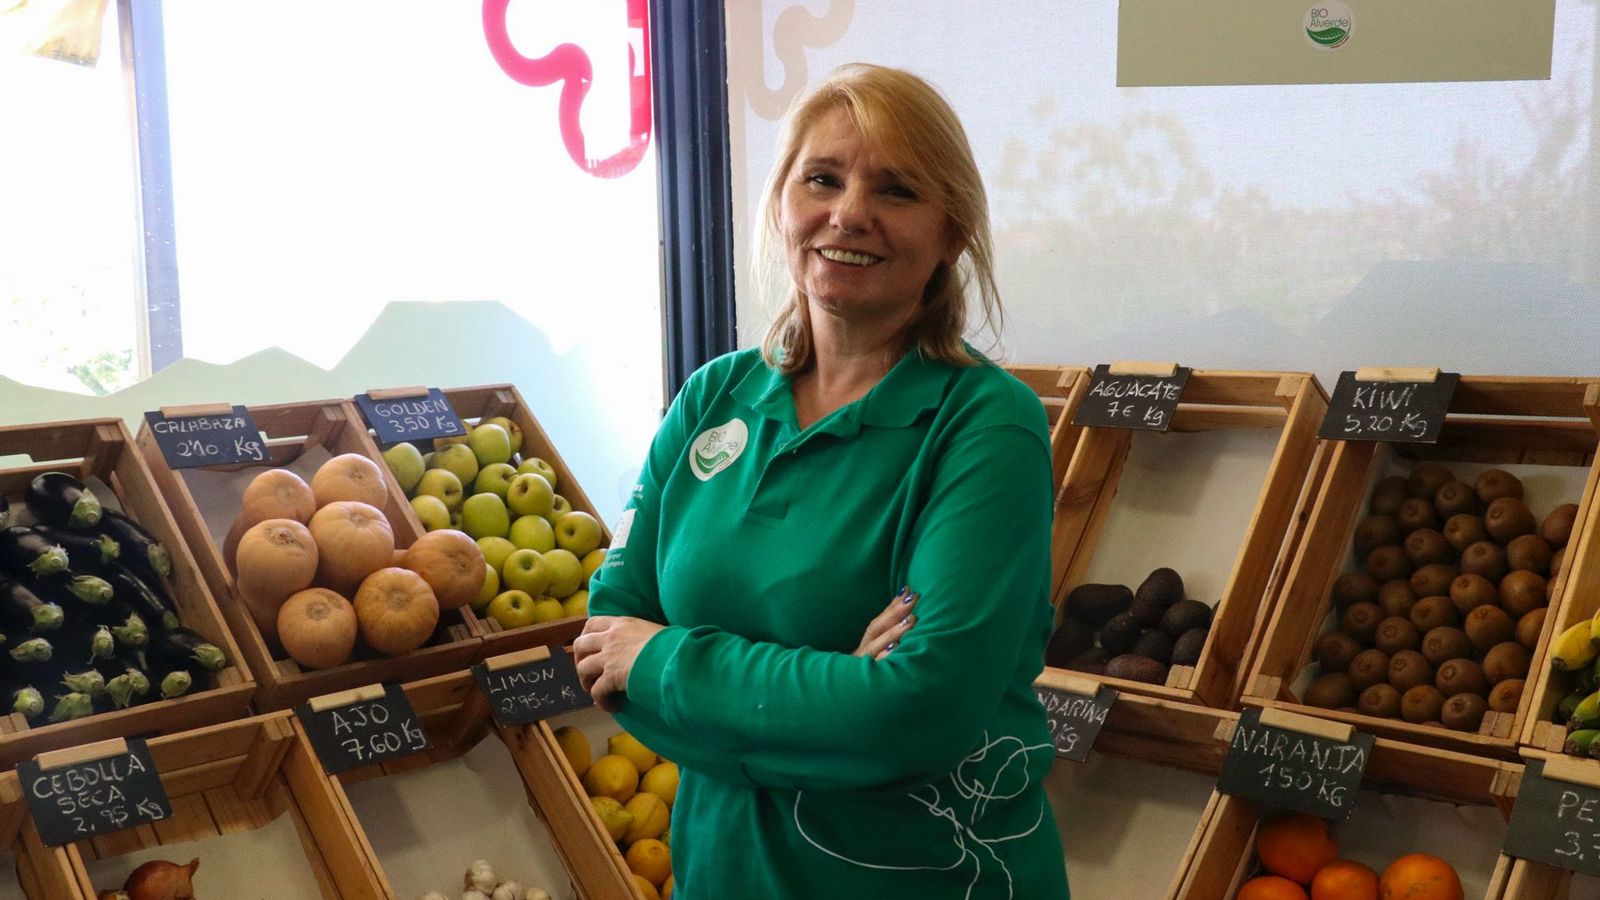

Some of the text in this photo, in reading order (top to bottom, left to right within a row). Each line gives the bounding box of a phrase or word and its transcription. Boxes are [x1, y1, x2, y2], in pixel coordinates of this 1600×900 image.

[1310, 18, 1349, 28] Alverde
[1311, 8, 1328, 18] BIO
[1090, 380, 1181, 400] AGUACATE
[375, 399, 449, 417] GOLDEN
[1143, 406, 1164, 426] Kg
[154, 418, 246, 433] CALABAZA
[389, 416, 458, 433] 3,50 Kg
[1344, 413, 1427, 438] 5,20 Kg
[235, 436, 263, 461] Kg
[486, 668, 555, 694] LIMON
[332, 704, 389, 735] AJO
[341, 718, 426, 760] 7,60 Kg
[1232, 725, 1366, 774] NARANJA
[33, 754, 146, 799] CEBOLLA
[57, 785, 126, 815] SECA
[136, 798, 164, 820] Kg
